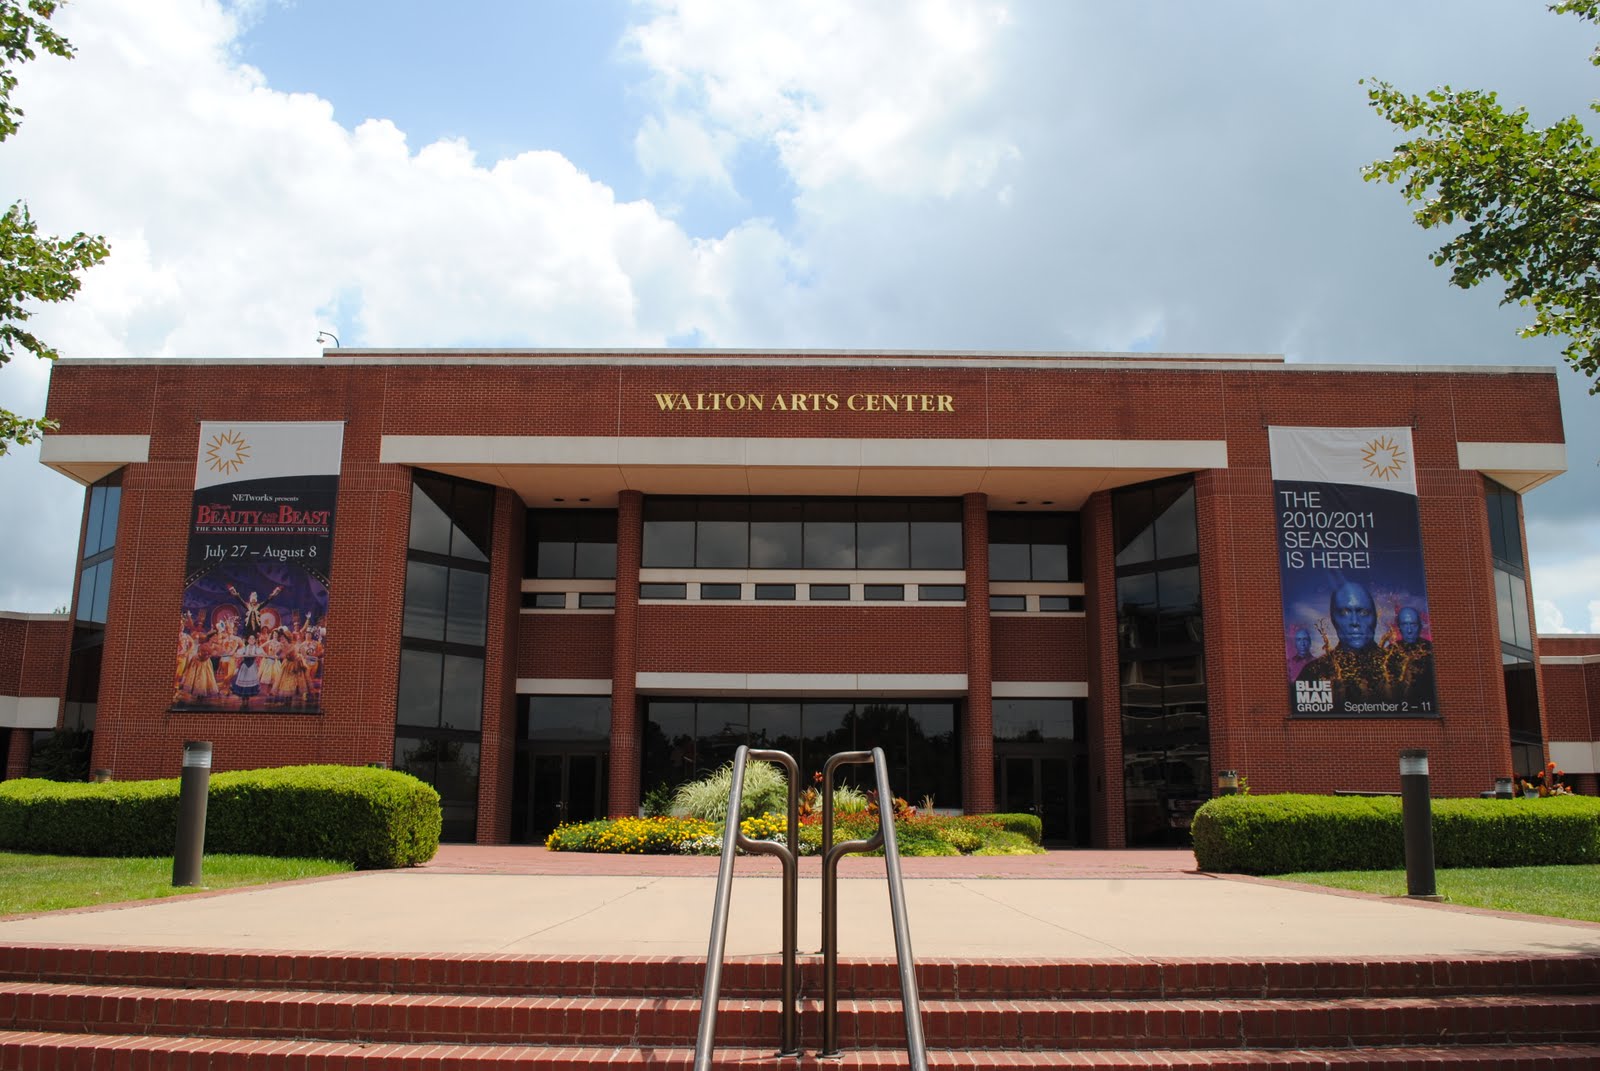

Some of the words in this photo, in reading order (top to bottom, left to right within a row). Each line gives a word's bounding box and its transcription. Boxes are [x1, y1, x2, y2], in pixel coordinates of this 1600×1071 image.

[654, 393, 764, 411] WALTON
[771, 393, 839, 411] ARTS
[846, 394, 955, 412] CENTER
[232, 494, 273, 502] NETworks
[1280, 491, 1321, 508] THE
[196, 505, 262, 524] BEAUTY
[278, 505, 330, 525] BEAST
[1282, 511, 1374, 528] 2010/2011
[1284, 531, 1369, 548] SEASON
[204, 545, 228, 562] July
[230, 545, 248, 557] 27
[263, 546, 305, 562] August
[308, 546, 317, 557] 8
[1286, 552, 1305, 569] IS
[1311, 552, 1370, 569] HERE!
[1295, 680, 1332, 691] BLUE
[1296, 691, 1333, 703] MAN
[1297, 703, 1334, 712] GROUP
[1344, 702, 1399, 713] September
[1402, 702, 1408, 711] 2
[1422, 702, 1431, 711] 11
